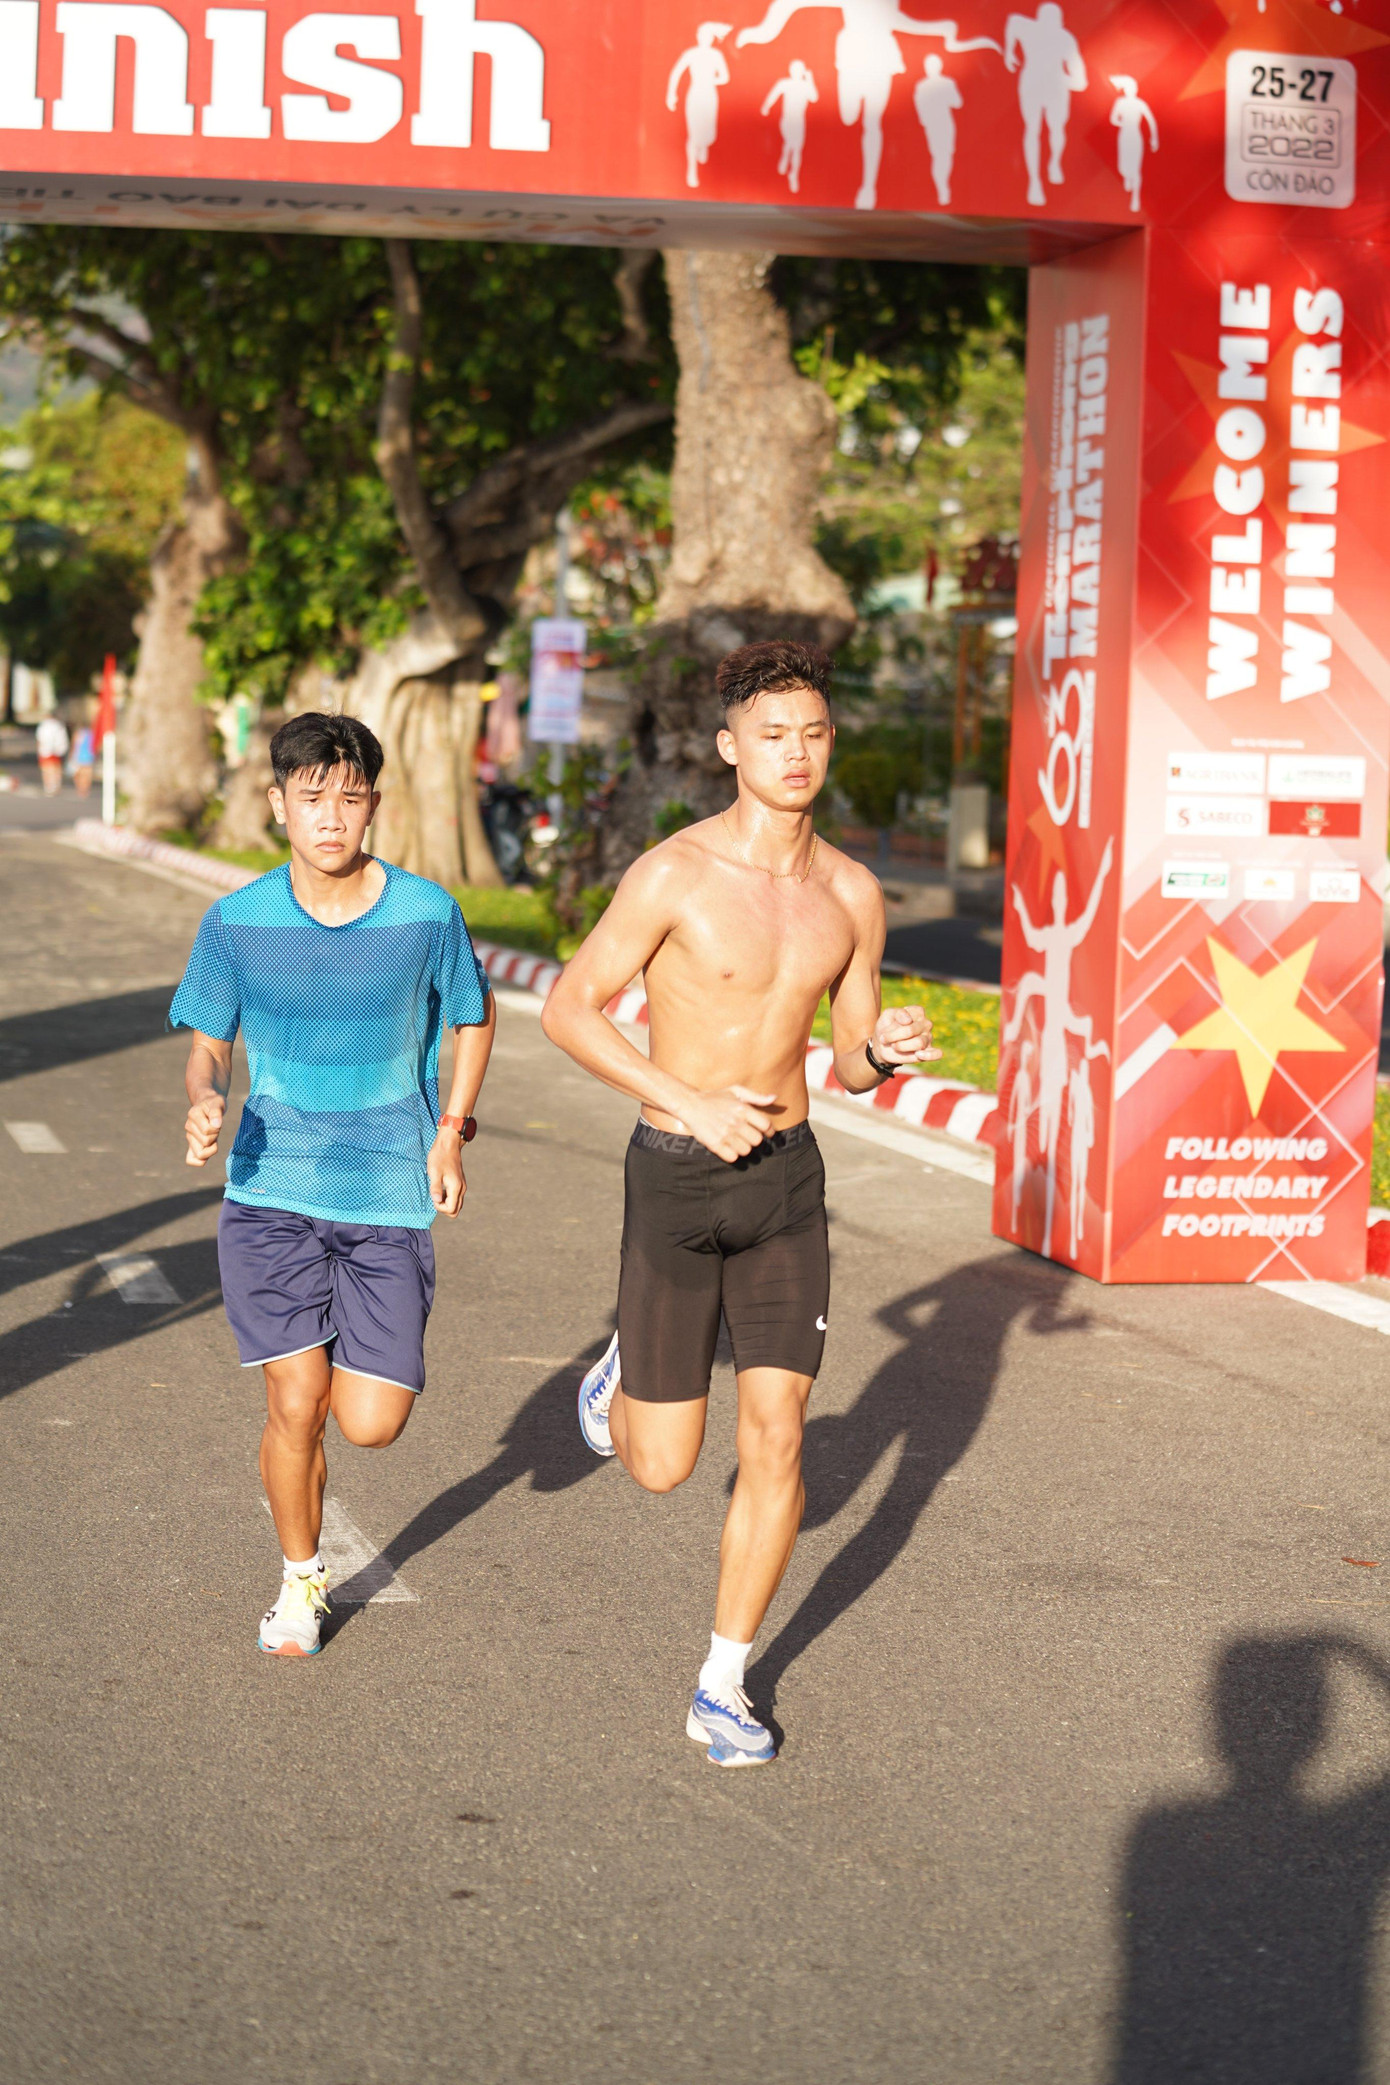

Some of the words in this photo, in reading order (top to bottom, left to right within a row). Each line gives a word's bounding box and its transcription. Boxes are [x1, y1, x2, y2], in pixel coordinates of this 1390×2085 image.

[1251, 66, 1334, 102] 25-27
[1323, 118, 1335, 135] 3
[1248, 135, 1334, 161] 2022
[1069, 314, 1109, 658] MARATHON
[1206, 282, 1270, 701] WELCOME
[1280, 286, 1344, 703] WINNERS
[636, 1128, 686, 1155] NIKE
[1164, 1137, 1328, 1161] FOLLOWING
[1163, 1175, 1329, 1199] LEGENDARY
[1161, 1213, 1326, 1237] FOOTPRINTS
